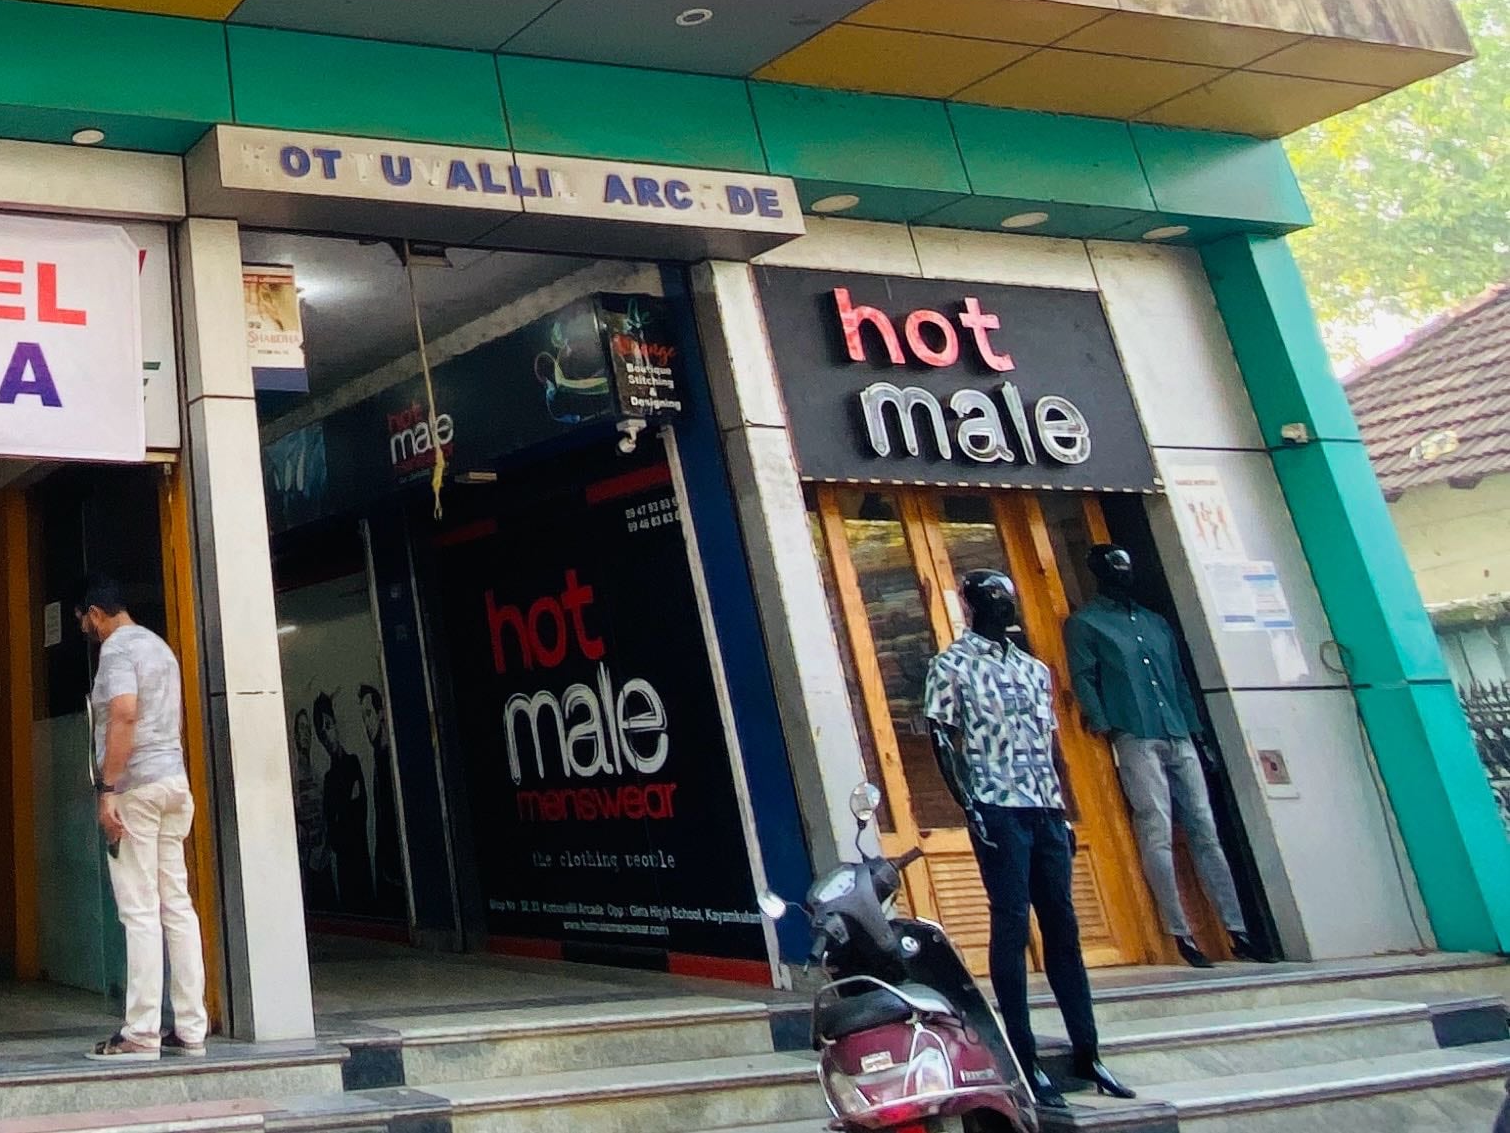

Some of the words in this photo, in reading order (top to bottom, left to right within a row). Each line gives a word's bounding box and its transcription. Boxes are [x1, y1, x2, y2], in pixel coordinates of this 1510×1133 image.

[604, 174, 783, 218] ARCDE
[834, 286, 1016, 372] hot
[628, 374, 674, 388] Stitching
[630, 396, 682, 412] Designing
[859, 380, 1090, 465] male
[485, 569, 605, 673] hot
[503, 661, 669, 785] male
[517, 782, 678, 821] menswear
[671, 906, 704, 922] School,
